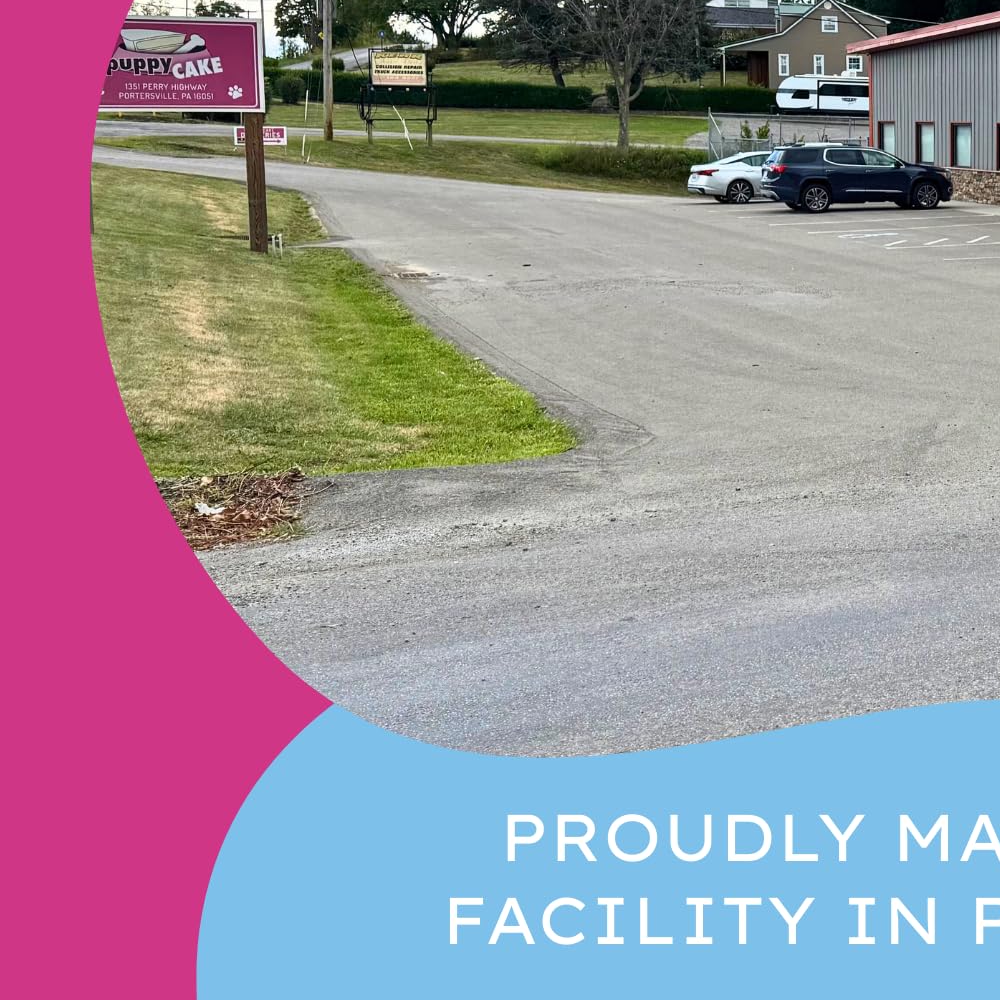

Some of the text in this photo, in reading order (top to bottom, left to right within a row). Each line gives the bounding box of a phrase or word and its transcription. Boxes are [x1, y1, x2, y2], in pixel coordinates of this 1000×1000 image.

[106, 56, 223, 79] puppy CAKE
[125, 83, 207, 91] 1351 PERRY HIGHWAY
[118, 92, 180, 100] PORTERSVILLE,
